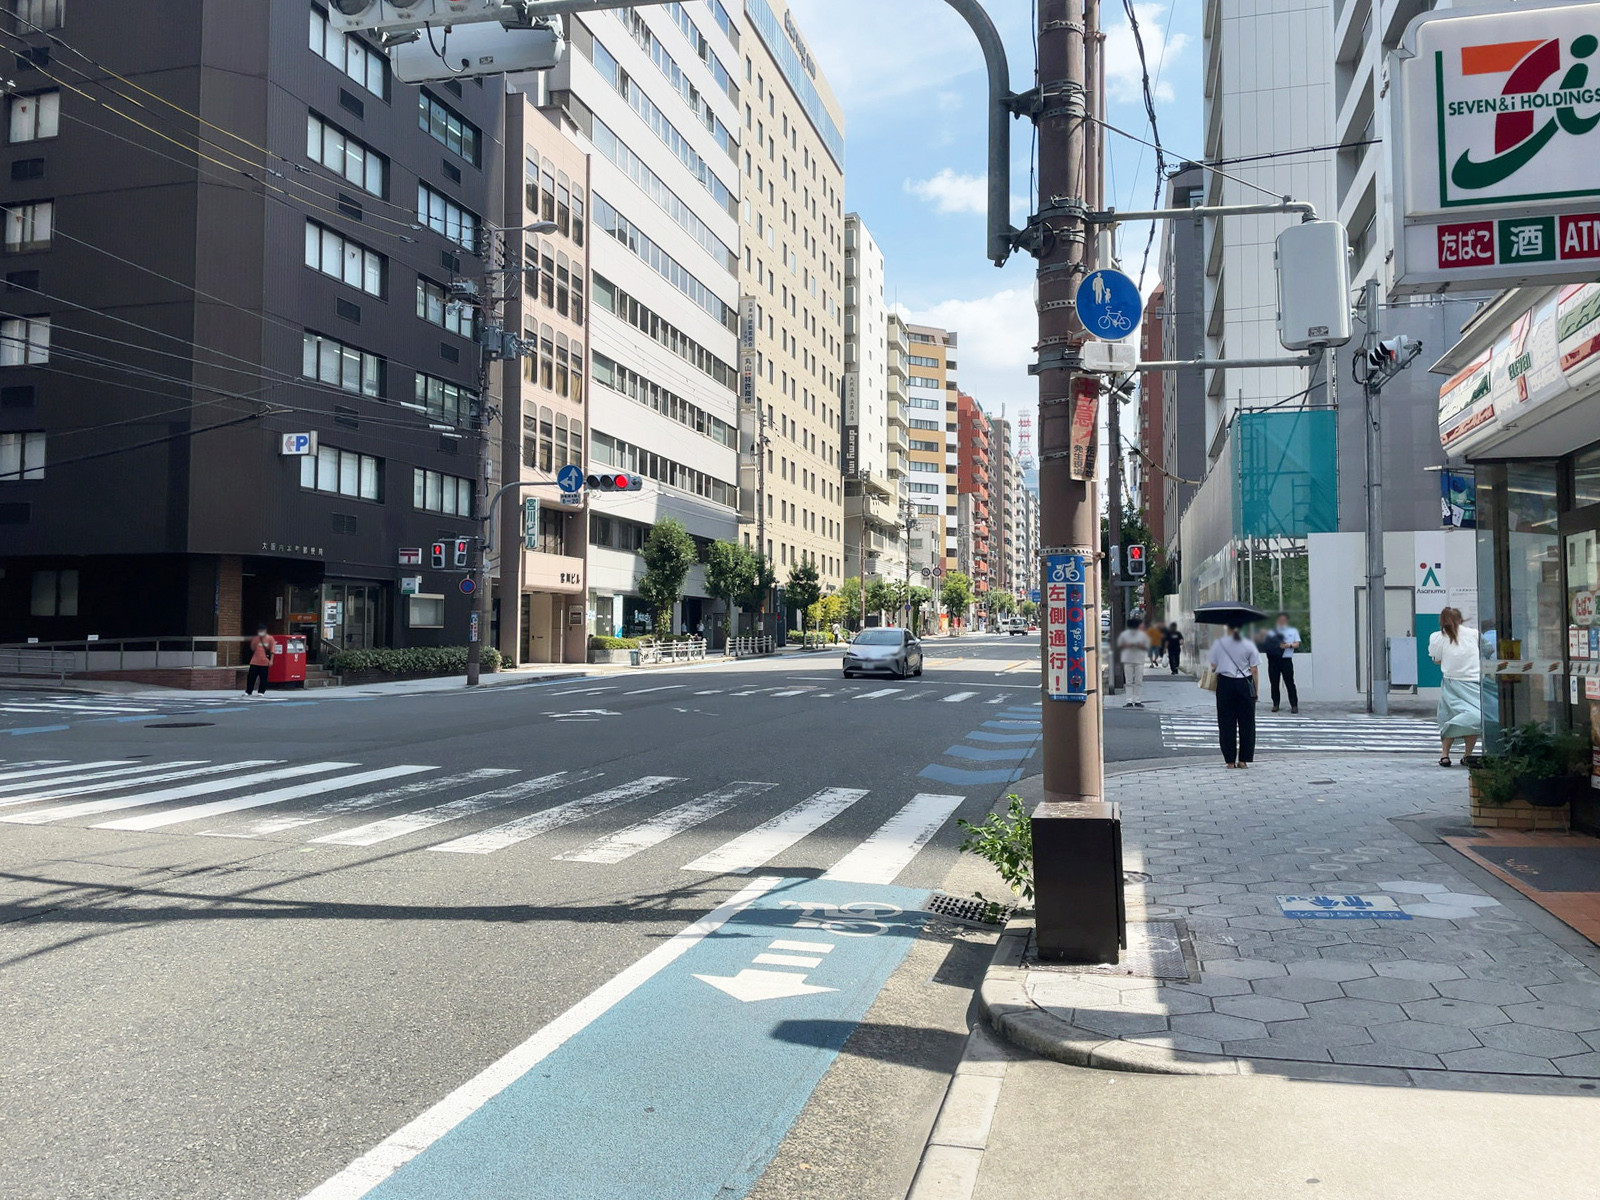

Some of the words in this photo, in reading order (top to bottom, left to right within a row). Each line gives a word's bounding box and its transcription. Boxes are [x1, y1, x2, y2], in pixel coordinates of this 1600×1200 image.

[1442, 228, 1492, 262] たばこ
[1510, 224, 1543, 258] 酒
[296, 435, 308, 452] P
[847, 429, 857, 459] dormy
[526, 498, 537, 549] 宮川ビル
[560, 572, 581, 585] 宮川ビル
[1048, 583, 1067, 692] 左側通行!
